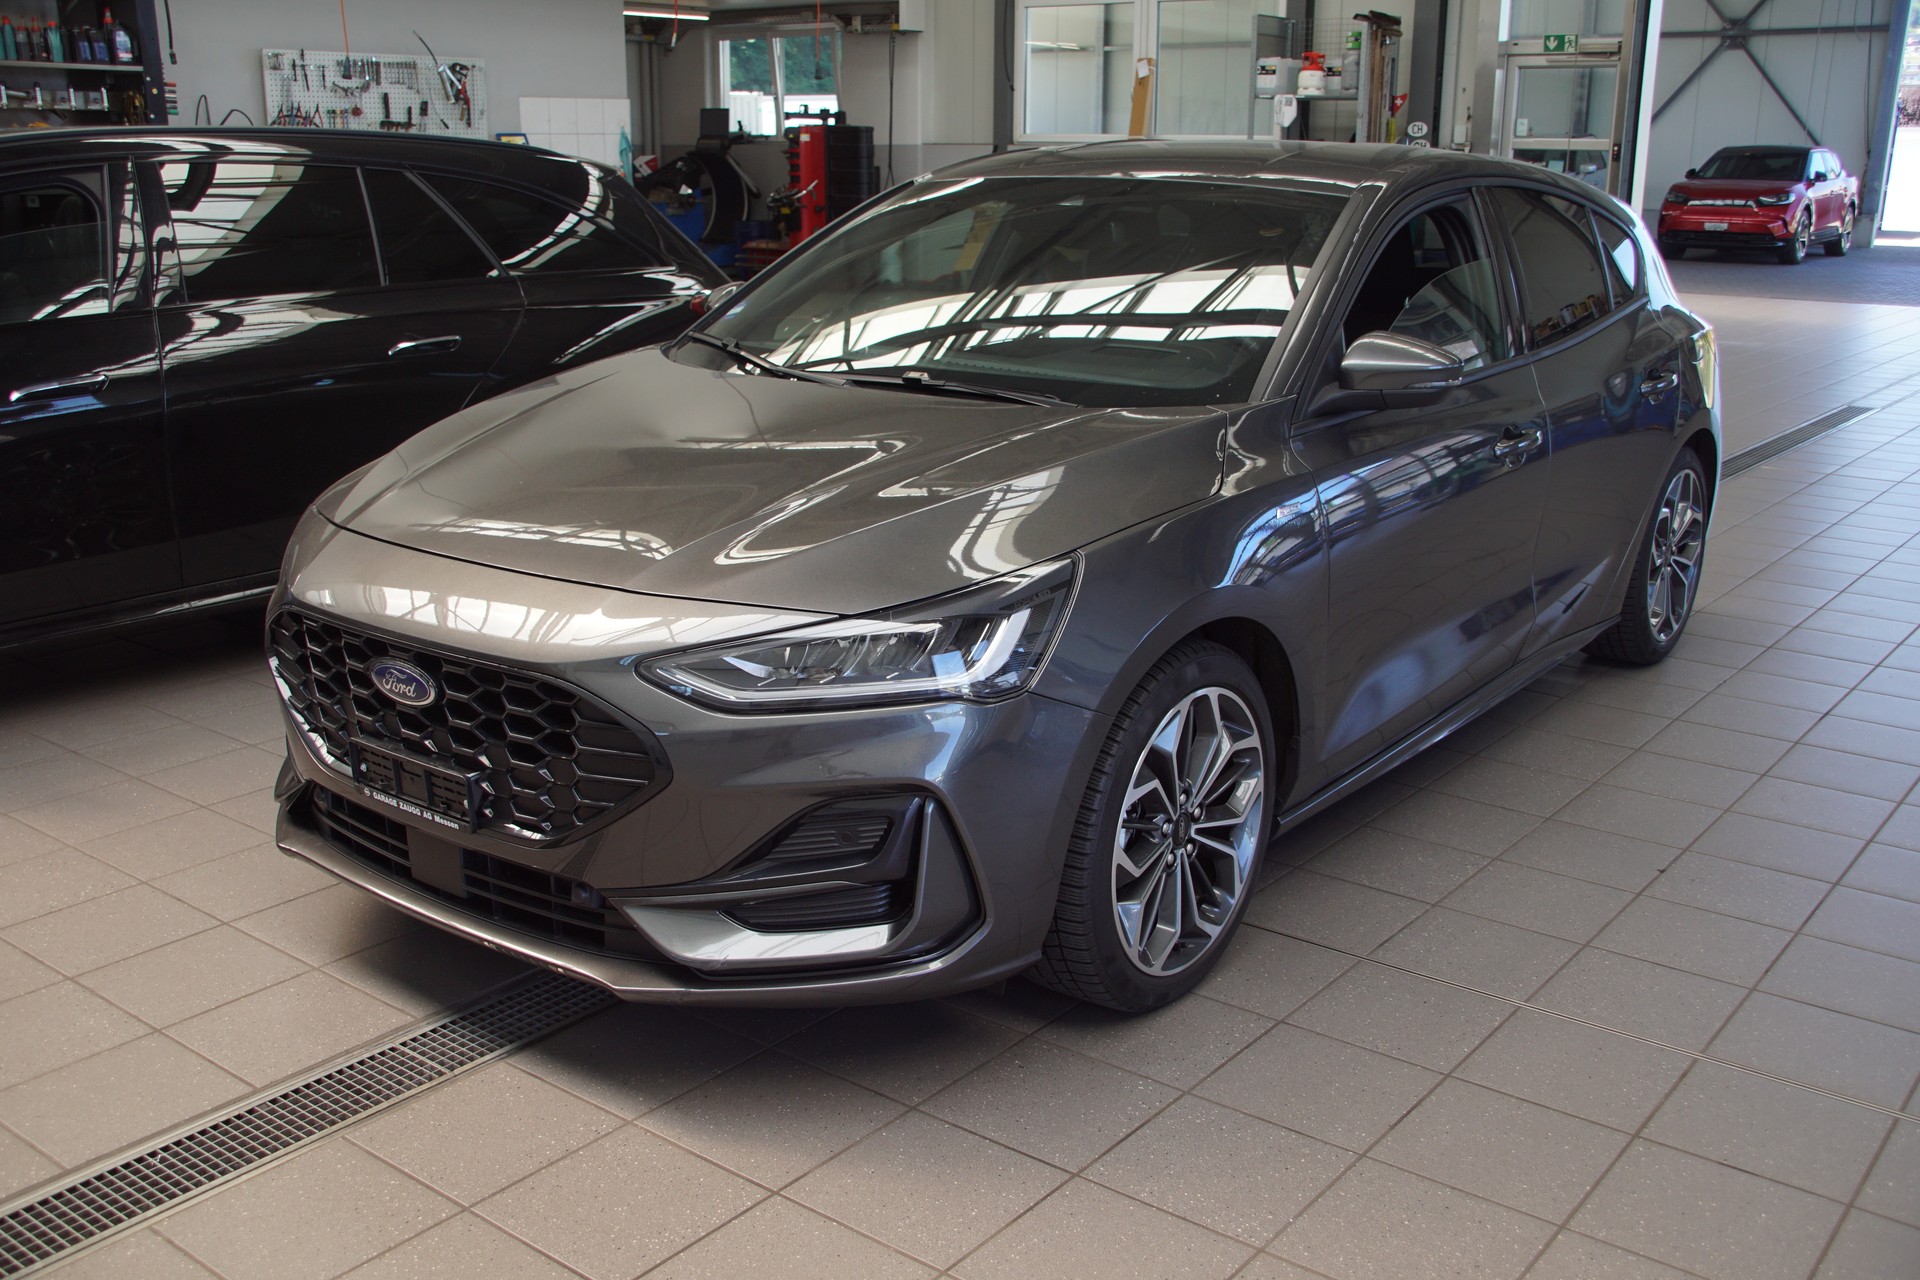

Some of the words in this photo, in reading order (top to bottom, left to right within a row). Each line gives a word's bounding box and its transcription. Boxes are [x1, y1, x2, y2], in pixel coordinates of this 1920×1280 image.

[1412, 124, 1423, 134] CH
[383, 669, 417, 697] Ford
[373, 792, 398, 807] GARAGE
[399, 802, 421, 816] ZAUGG
[423, 811, 432, 820] AG
[434, 815, 459, 830] Messen
